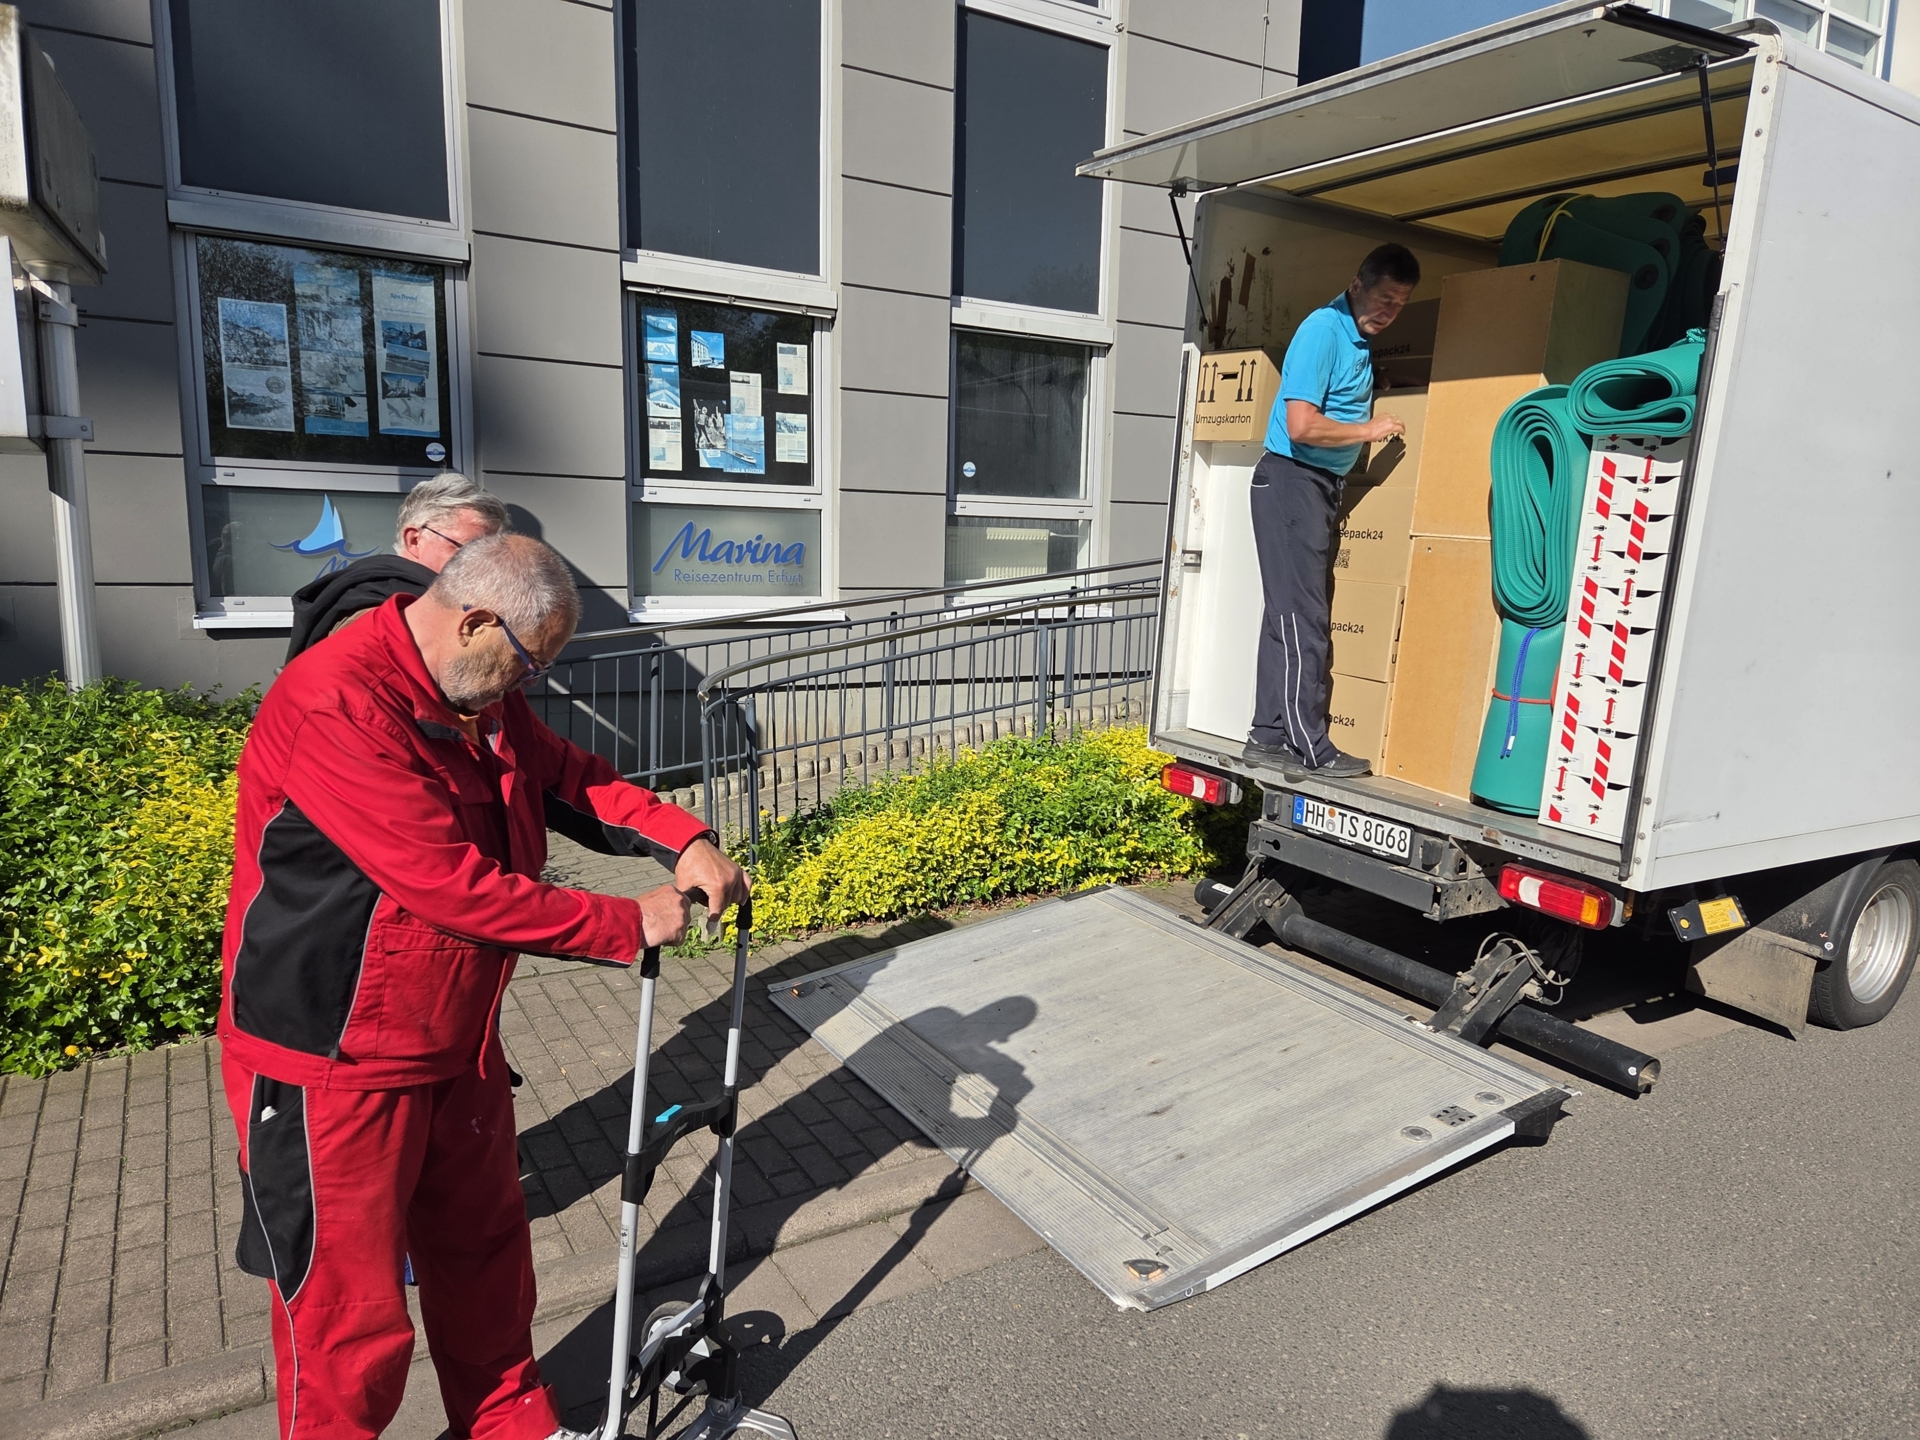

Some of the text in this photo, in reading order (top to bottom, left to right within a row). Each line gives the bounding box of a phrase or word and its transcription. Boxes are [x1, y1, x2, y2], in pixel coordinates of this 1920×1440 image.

[1372, 344, 1411, 359] epack24
[1195, 413, 1251, 426] Umzugskarton
[652, 520, 806, 573] Marina
[674, 568, 803, 583] Reisezentrum Erfurt
[1331, 621, 1364, 634] pack24
[1305, 801, 1408, 853] HH TS 8068
